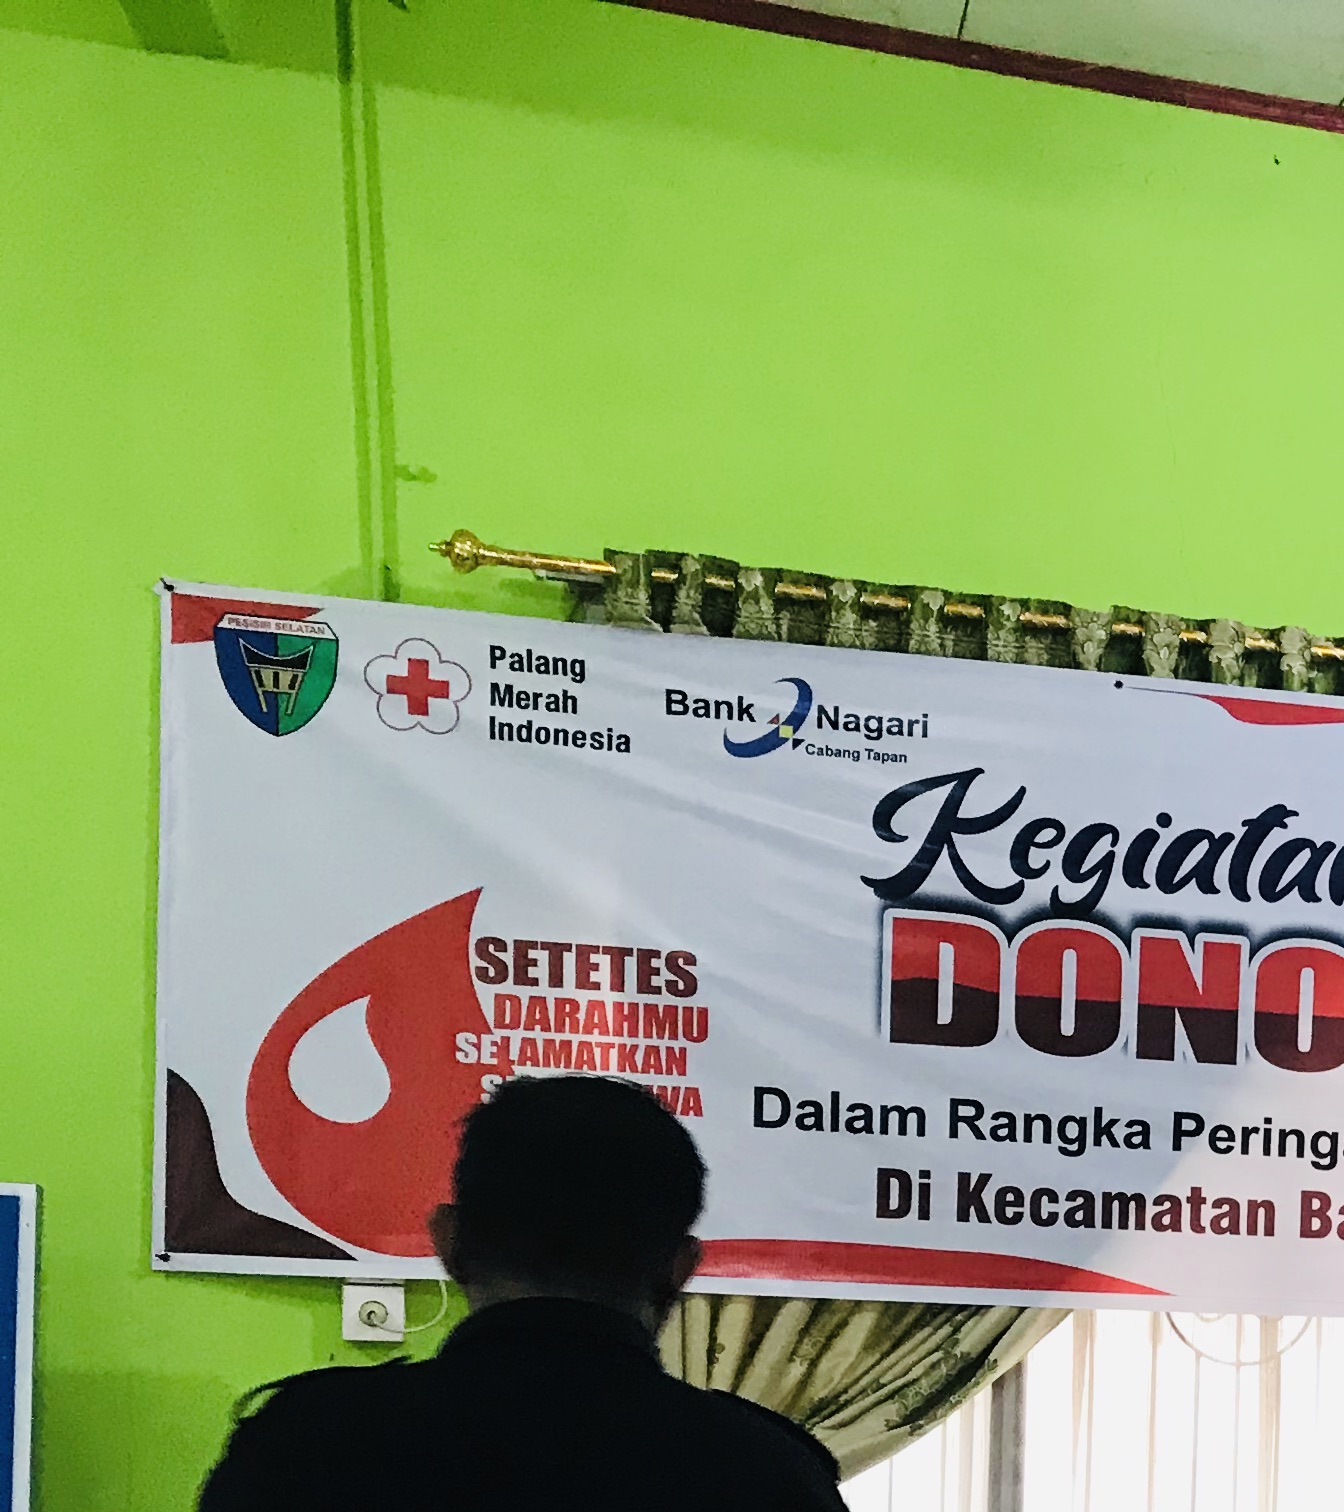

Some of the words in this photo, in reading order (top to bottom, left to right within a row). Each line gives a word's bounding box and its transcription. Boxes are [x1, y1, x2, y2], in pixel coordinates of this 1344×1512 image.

[274, 621, 326, 635] SELATAN
[489, 645, 586, 683] Palang
[489, 682, 579, 715] Merah
[664, 688, 757, 723] Bank
[815, 704, 929, 741] Nagari
[489, 716, 632, 754] Indonesia
[804, 743, 862, 762] Cabang
[864, 748, 909, 764] Tapan
[474, 936, 699, 998] SETETES
[493, 993, 709, 1044] DARAHMU
[454, 1031, 687, 1077] SELAMATKAN
[753, 1086, 926, 1138] Dalam
[948, 1098, 1152, 1157] Rangka
[875, 1167, 932, 1221] Di
[955, 1172, 1276, 1237] Kecamatan
